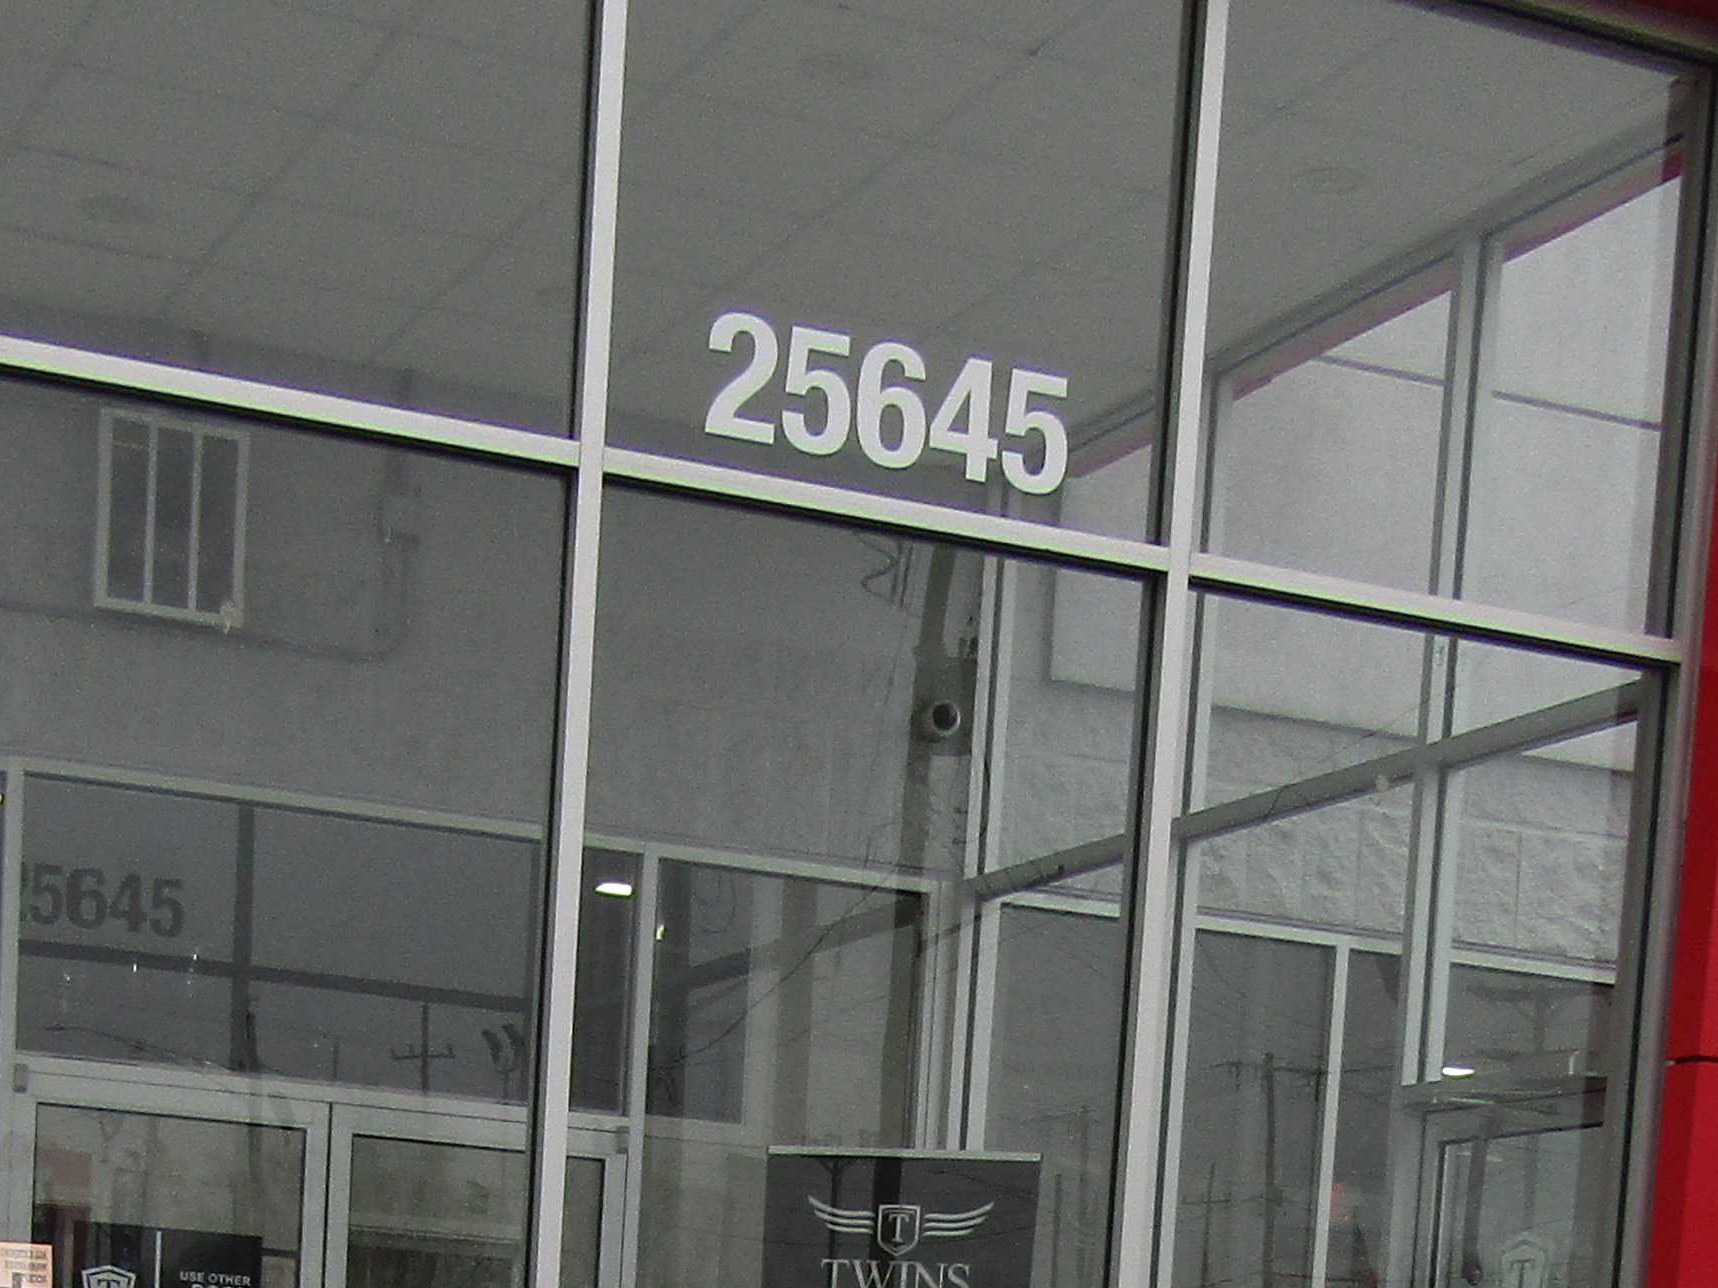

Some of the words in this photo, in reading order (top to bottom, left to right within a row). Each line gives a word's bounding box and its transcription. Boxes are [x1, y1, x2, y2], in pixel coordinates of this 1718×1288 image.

[704, 311, 1069, 495] 25645
[887, 1213, 910, 1242] T
[179, 1270, 205, 1283] USE
[208, 1272, 251, 1287] OTHER
